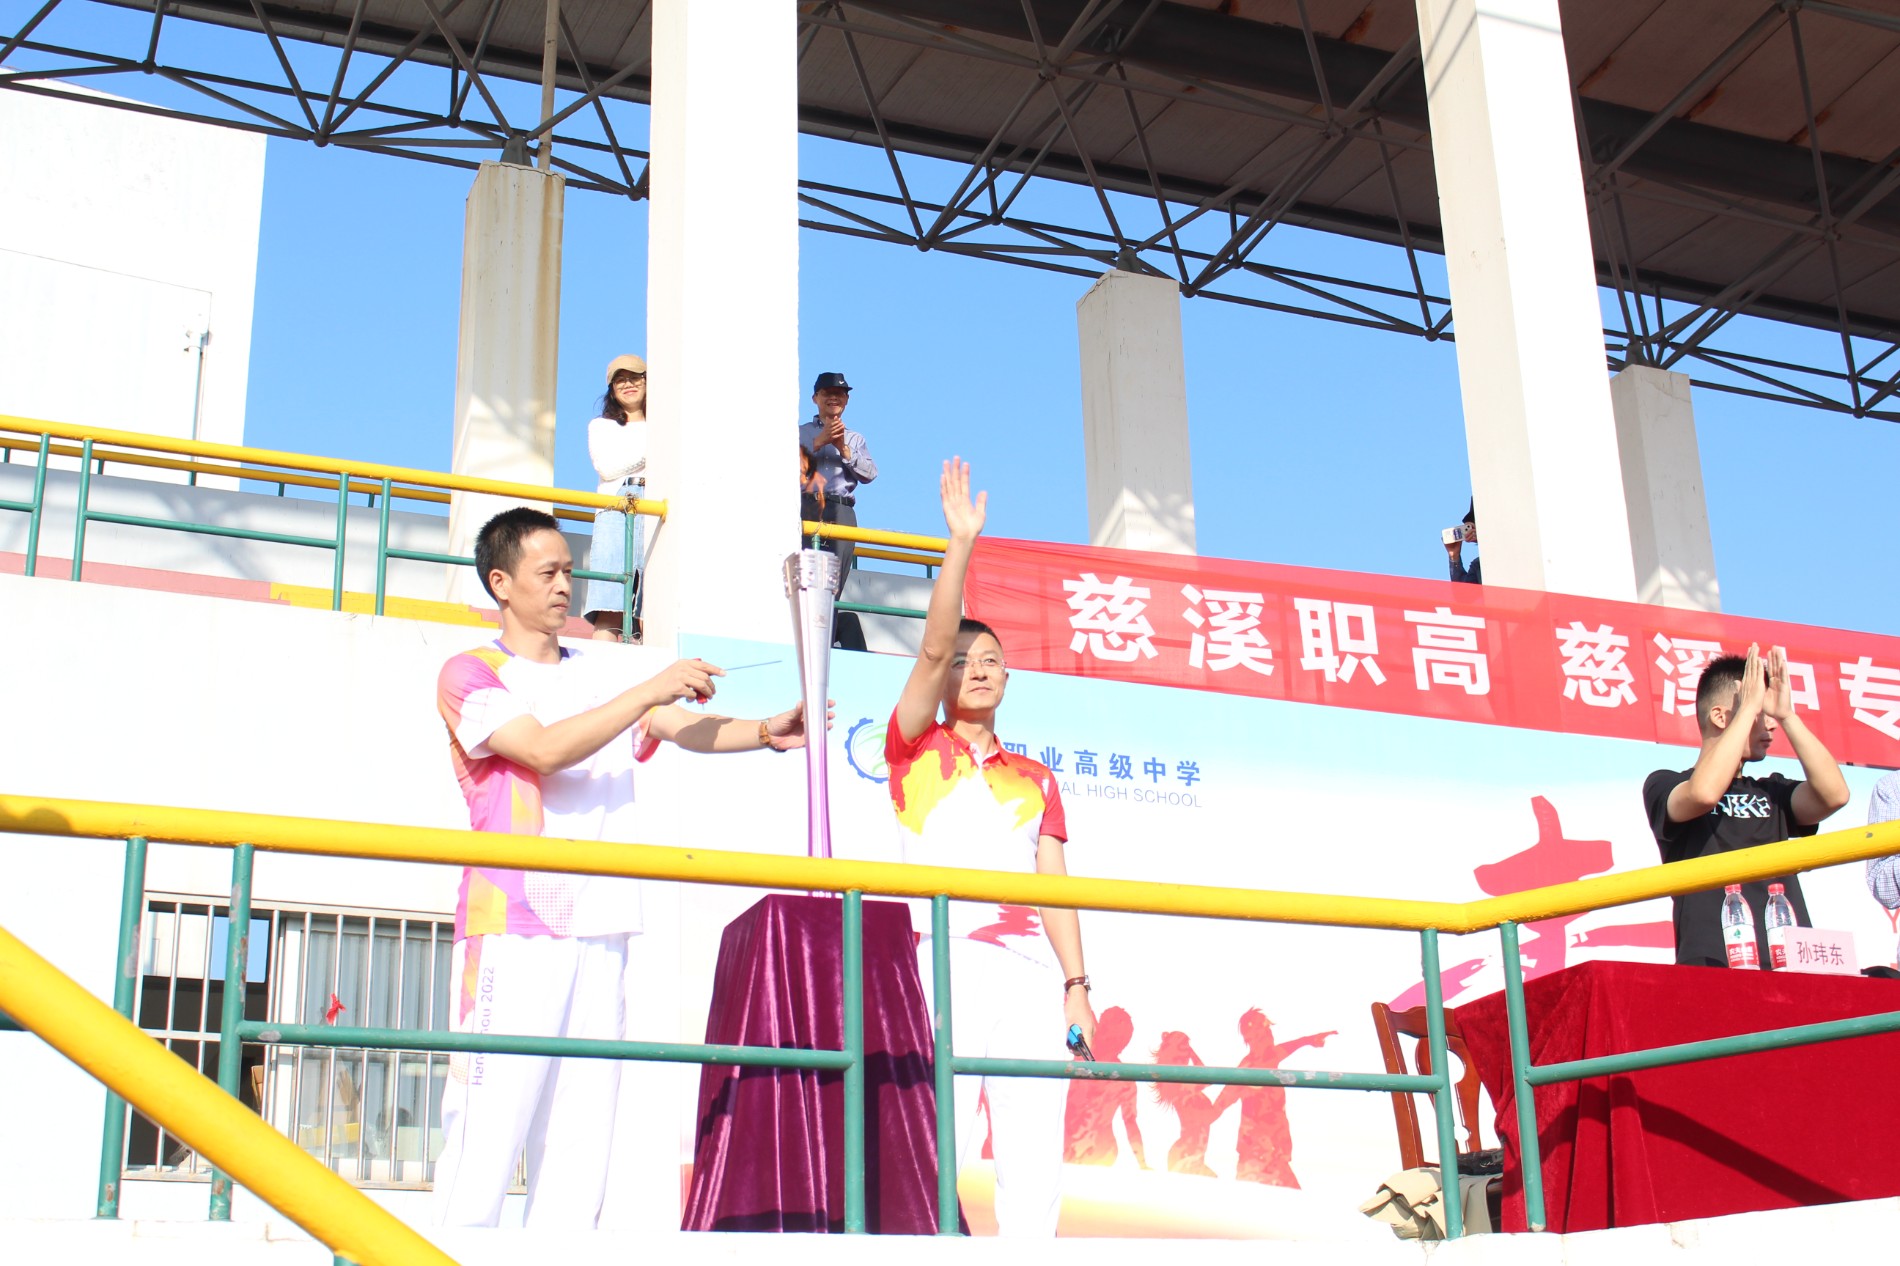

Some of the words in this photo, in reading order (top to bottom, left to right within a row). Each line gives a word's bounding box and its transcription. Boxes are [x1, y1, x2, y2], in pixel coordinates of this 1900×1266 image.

[1062, 572, 1491, 695] 慈溪职高
[1057, 780, 1081, 797] AL
[1087, 783, 1128, 801] HIGH
[1133, 788, 1202, 808] SCHOOL
[1796, 941, 1845, 965] 孙玮东
[481, 966, 495, 1003] 2022
[471, 1008, 492, 1086] Hanou
